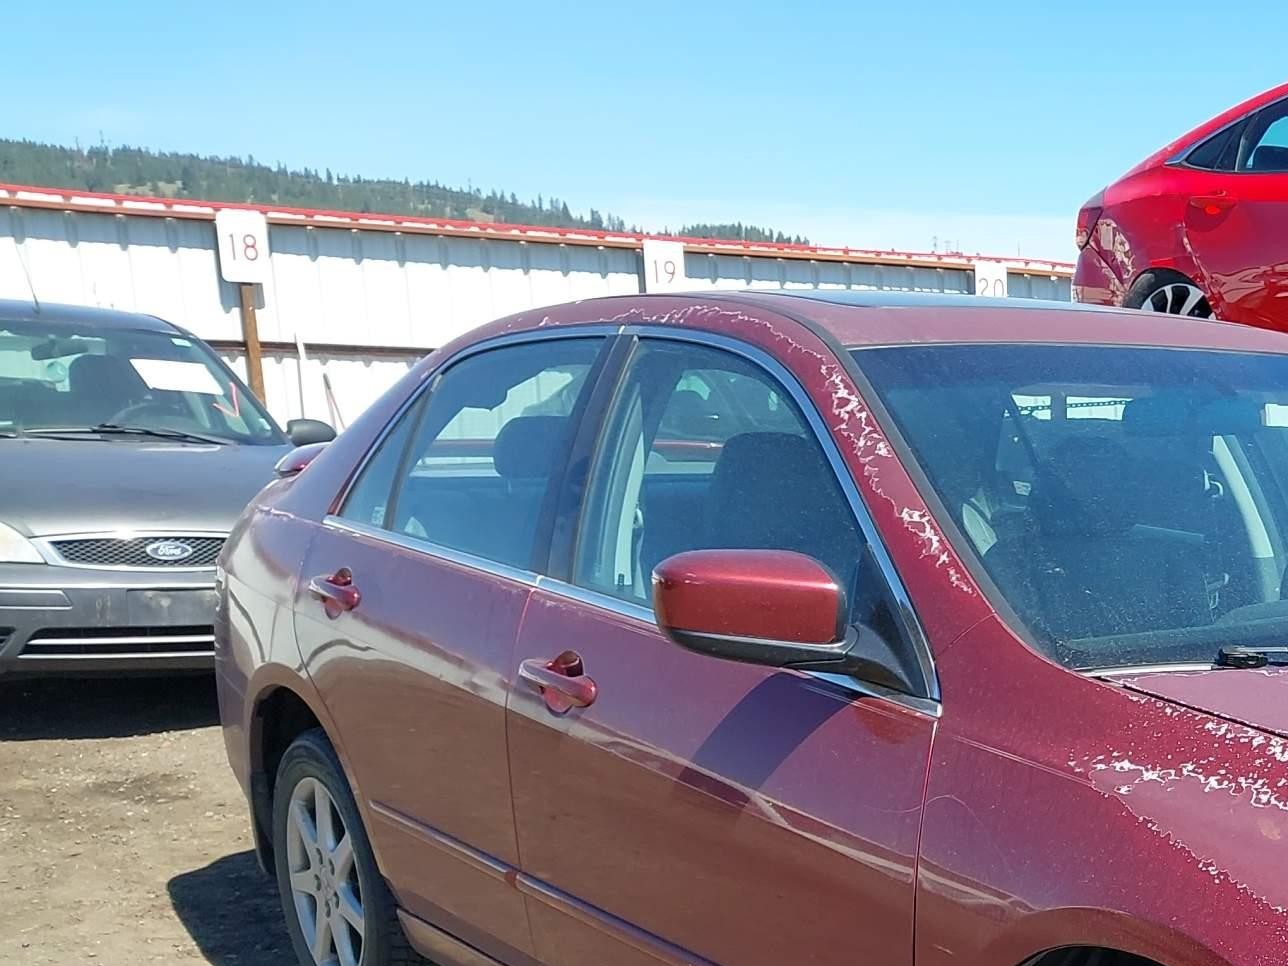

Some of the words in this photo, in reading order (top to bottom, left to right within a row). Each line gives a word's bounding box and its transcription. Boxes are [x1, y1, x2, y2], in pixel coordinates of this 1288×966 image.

[229, 233, 259, 262] 18
[654, 260, 676, 284] 19
[978, 277, 1005, 297] 20
